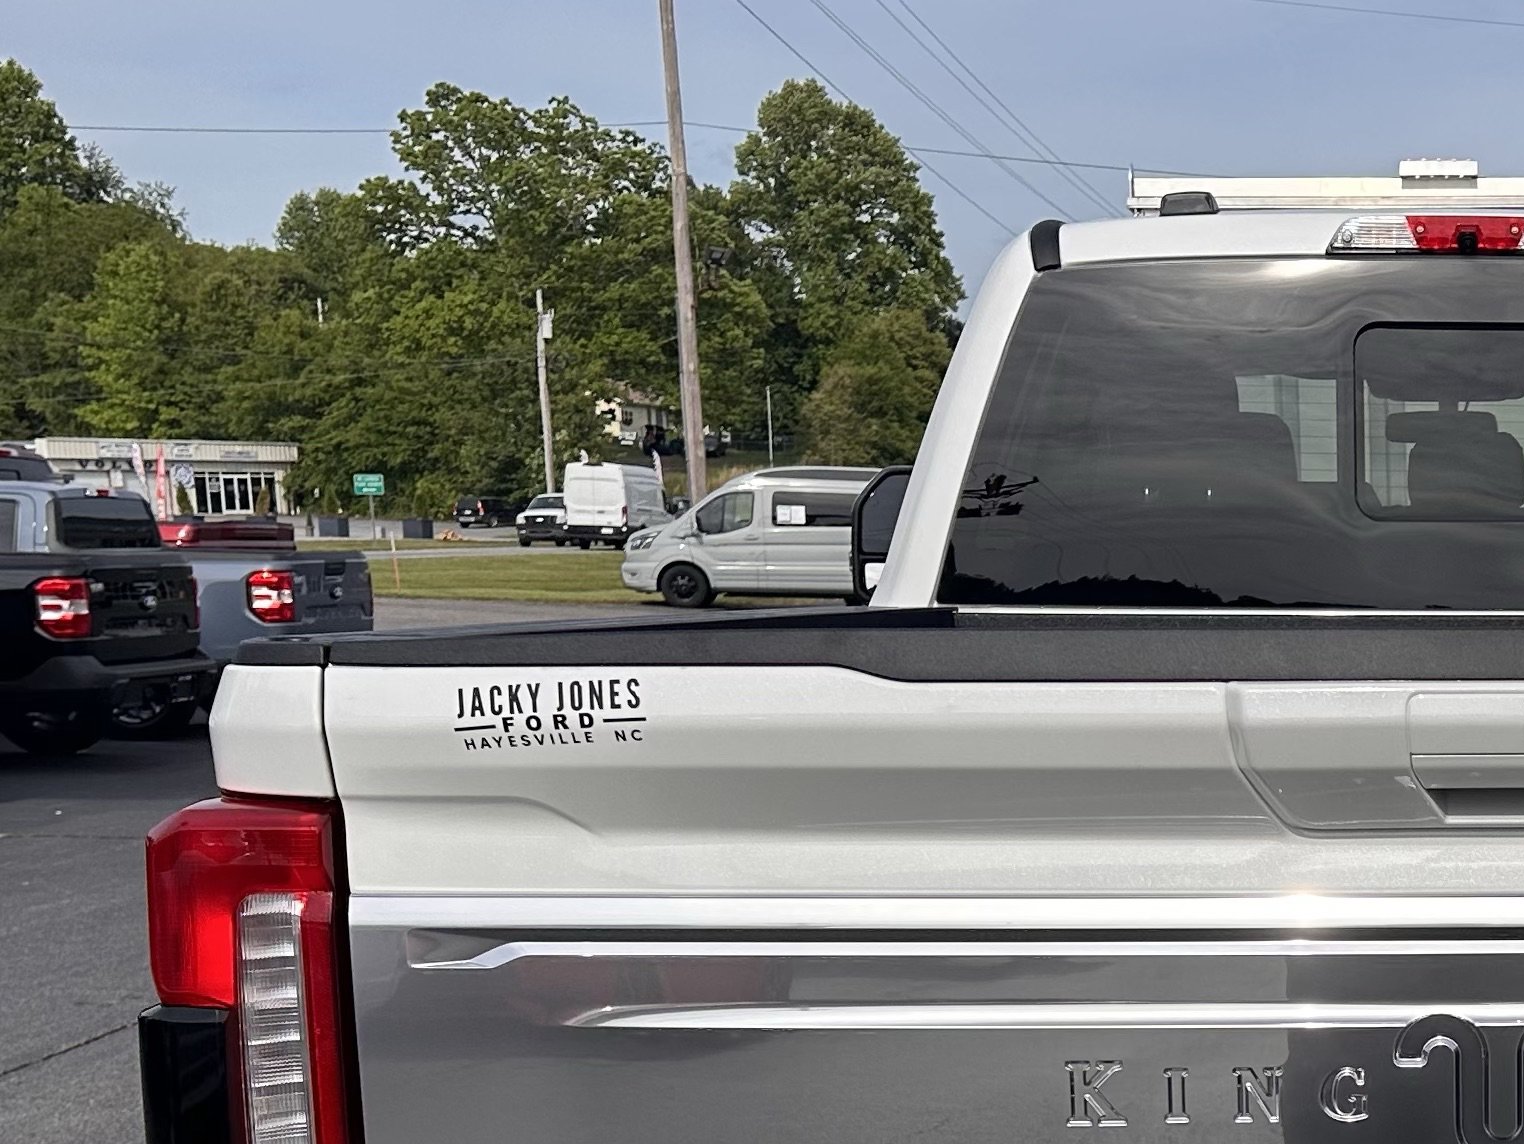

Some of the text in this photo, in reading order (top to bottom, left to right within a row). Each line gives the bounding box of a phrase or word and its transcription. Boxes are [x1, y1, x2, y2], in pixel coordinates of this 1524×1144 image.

[457, 678, 641, 719] JACKY JONES
[502, 712, 595, 733] FORD
[464, 729, 643, 750] HAYESVILLE NC
[1064, 1060, 1370, 1128] KING
